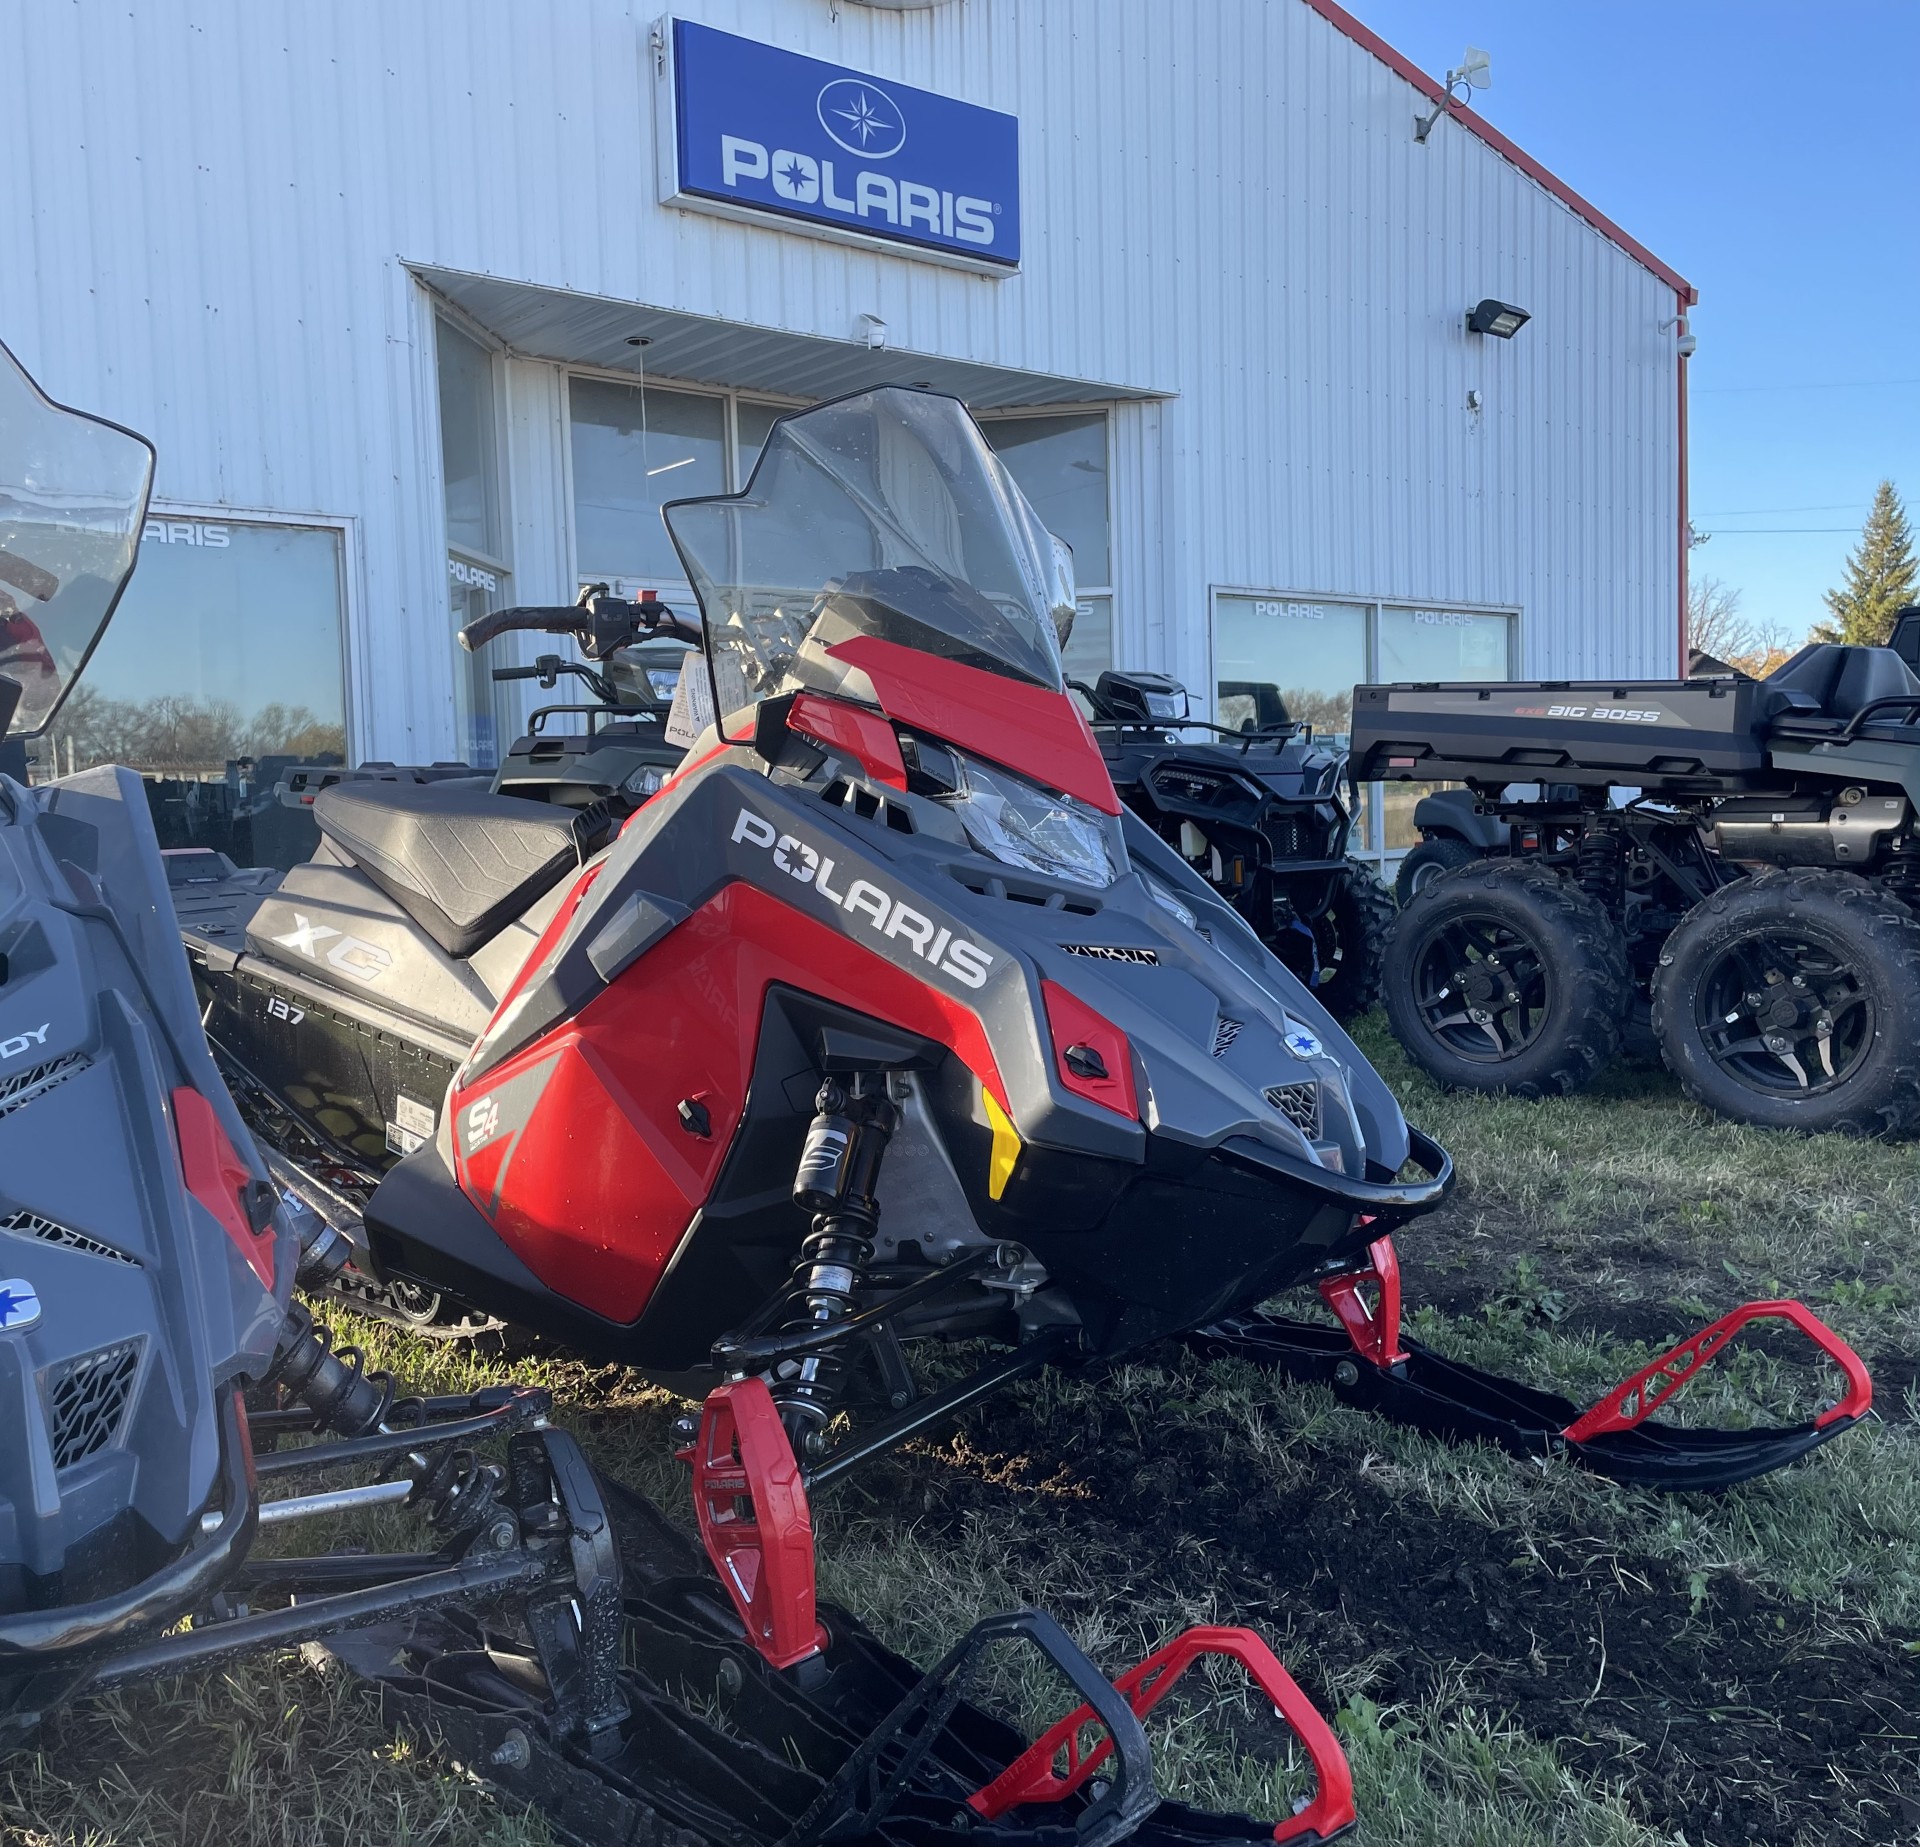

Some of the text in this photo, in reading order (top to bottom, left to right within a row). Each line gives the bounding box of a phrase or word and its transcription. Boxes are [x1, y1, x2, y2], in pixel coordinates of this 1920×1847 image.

[448, 560, 496, 593] POLARIS
[1255, 601, 1325, 620] POLARIS
[1414, 610, 1473, 626] POLARIS
[690, 687, 700, 717] WARNING
[1547, 705, 1588, 718] BIG
[1591, 707, 1661, 722] BOSS
[730, 808, 994, 989] POLARIS
[271, 912, 394, 982] XC
[267, 997, 305, 1026] 137
[467, 1095, 499, 1144] S4
[704, 1478, 746, 1489] POLARIS
